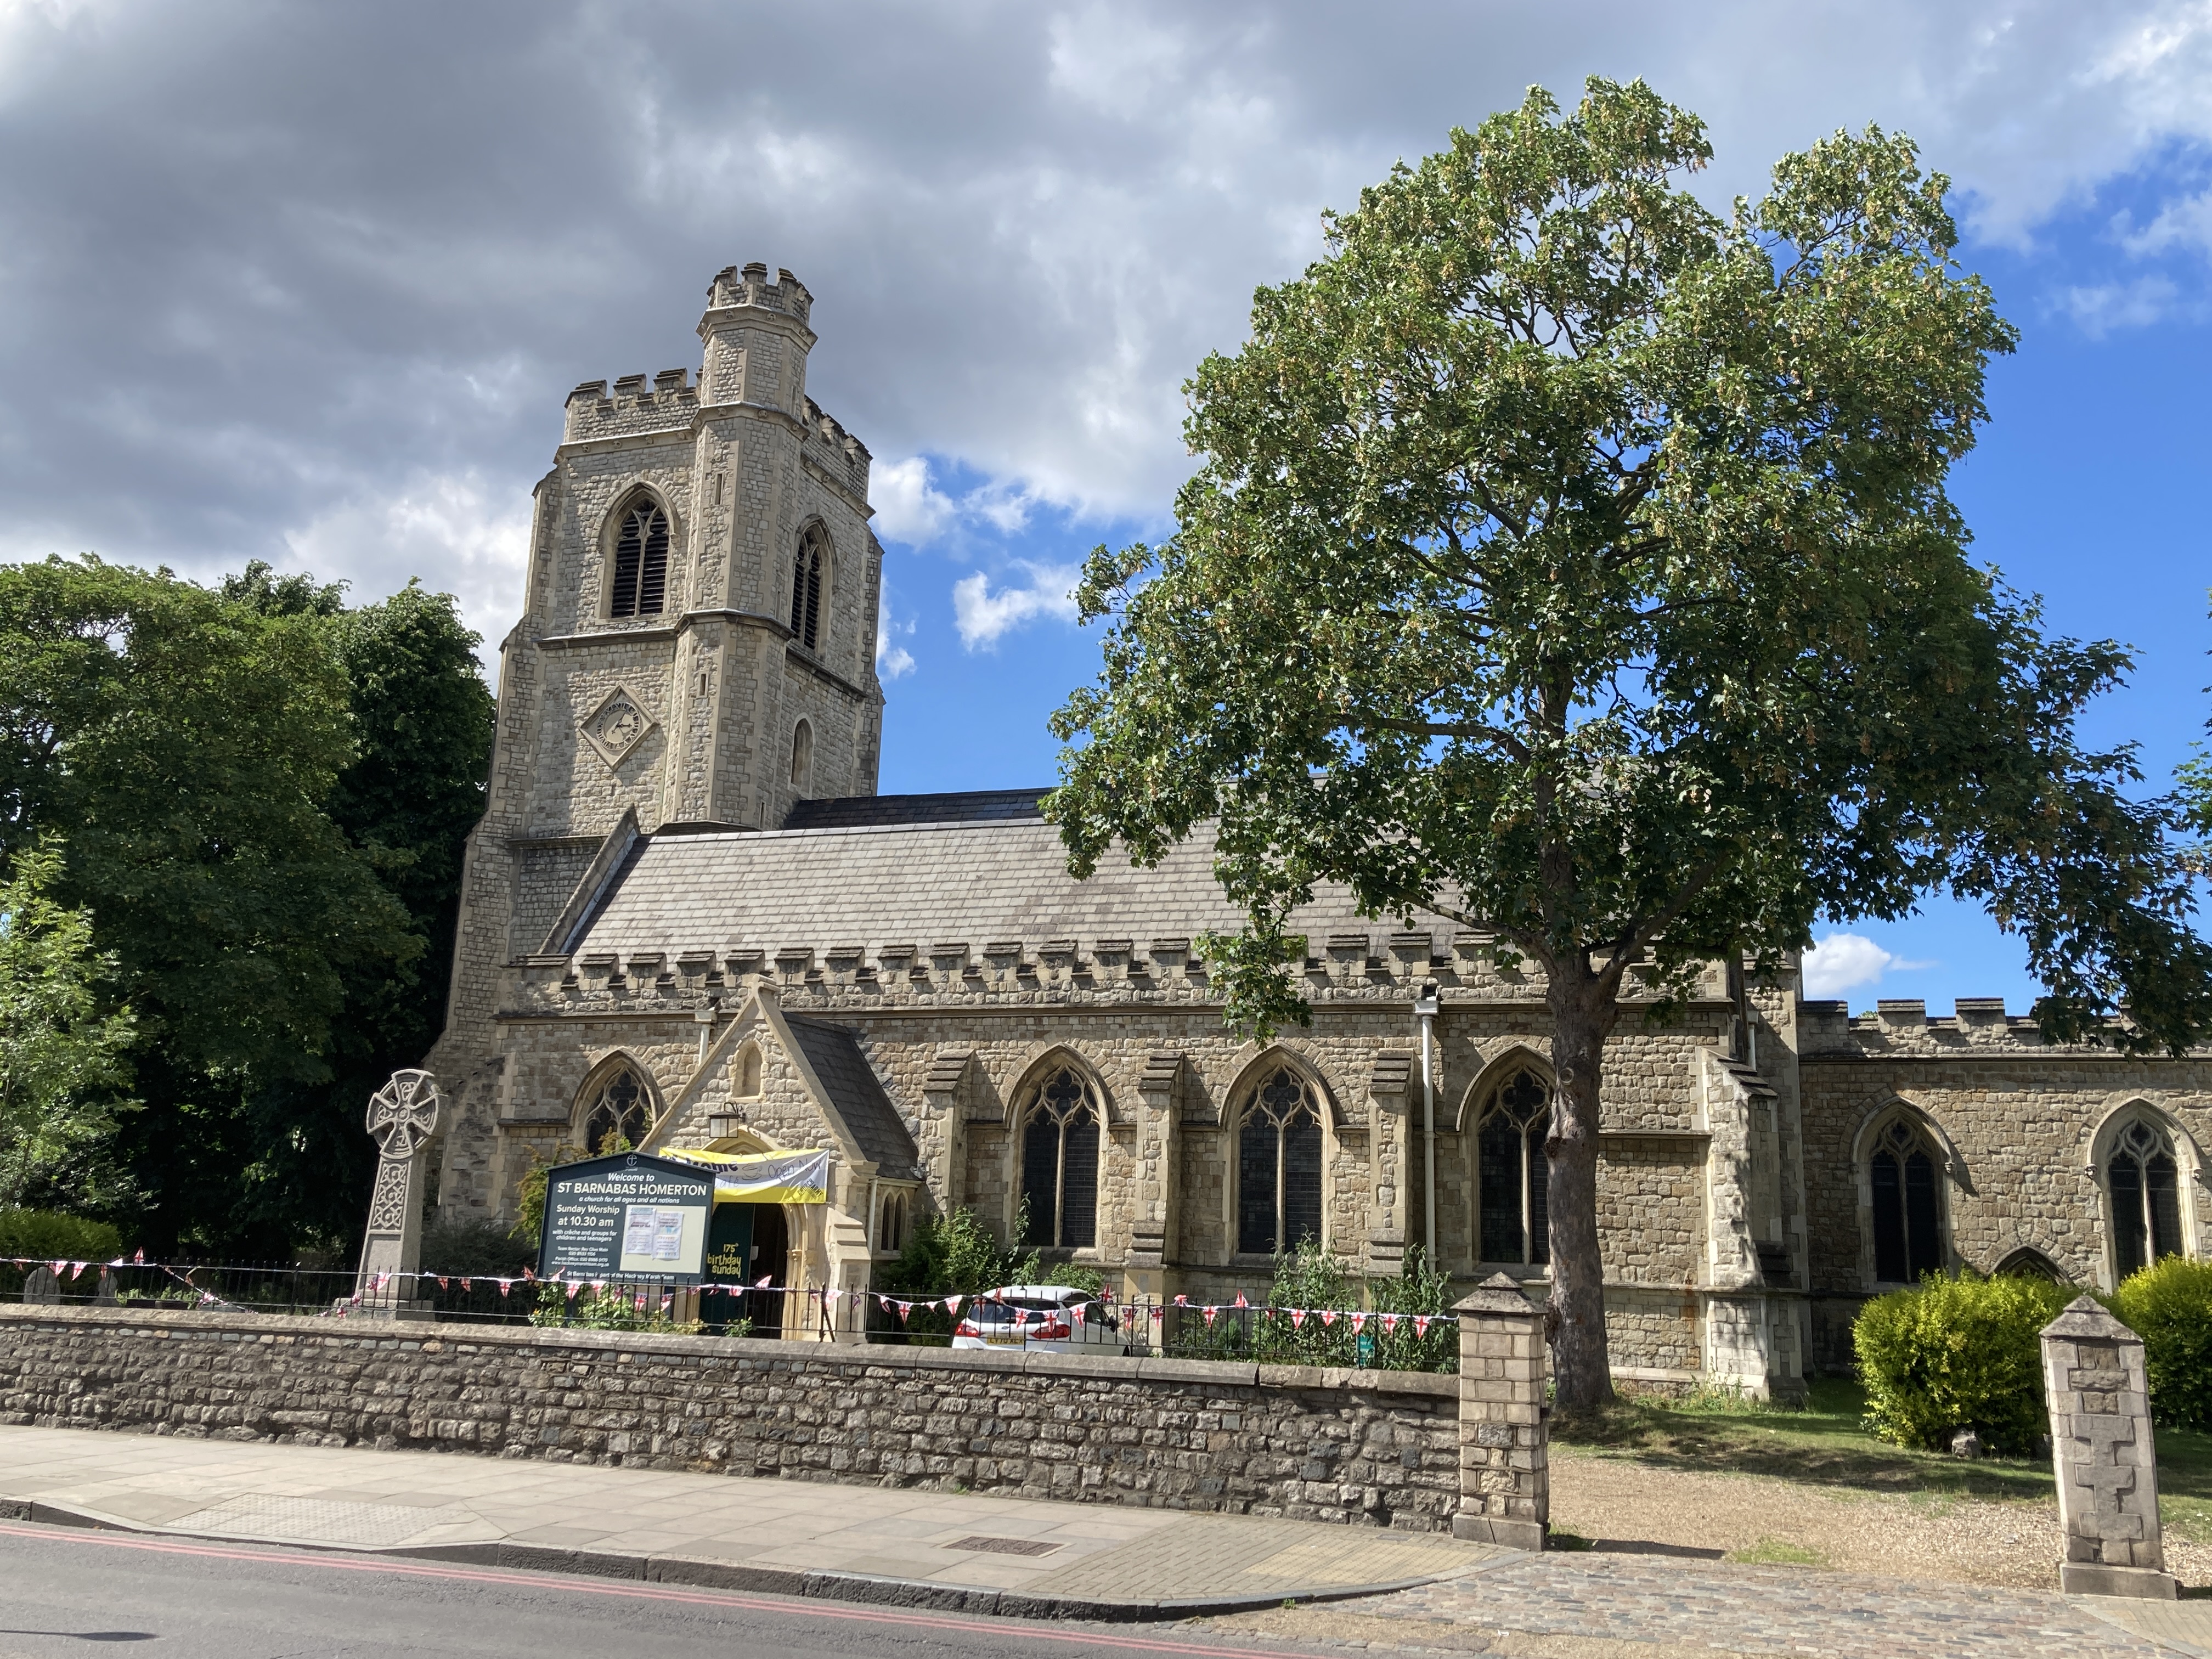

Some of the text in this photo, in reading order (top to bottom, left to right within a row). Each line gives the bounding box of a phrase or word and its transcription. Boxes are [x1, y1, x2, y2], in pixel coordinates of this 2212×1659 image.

[768, 1158, 821, 1178] Open Now
[608, 1173, 644, 1181] Welcome
[557, 1182, 707, 1196] ST BARNABAS HOMERTON
[797, 1178, 815, 1196] CHURCH
[810, 1184, 823, 1197] ARMY
[556, 1204, 620, 1215] Sunday Worship
[557, 1216, 614, 1227] at 10.30 am
[707, 1252, 741, 1267] birthday
